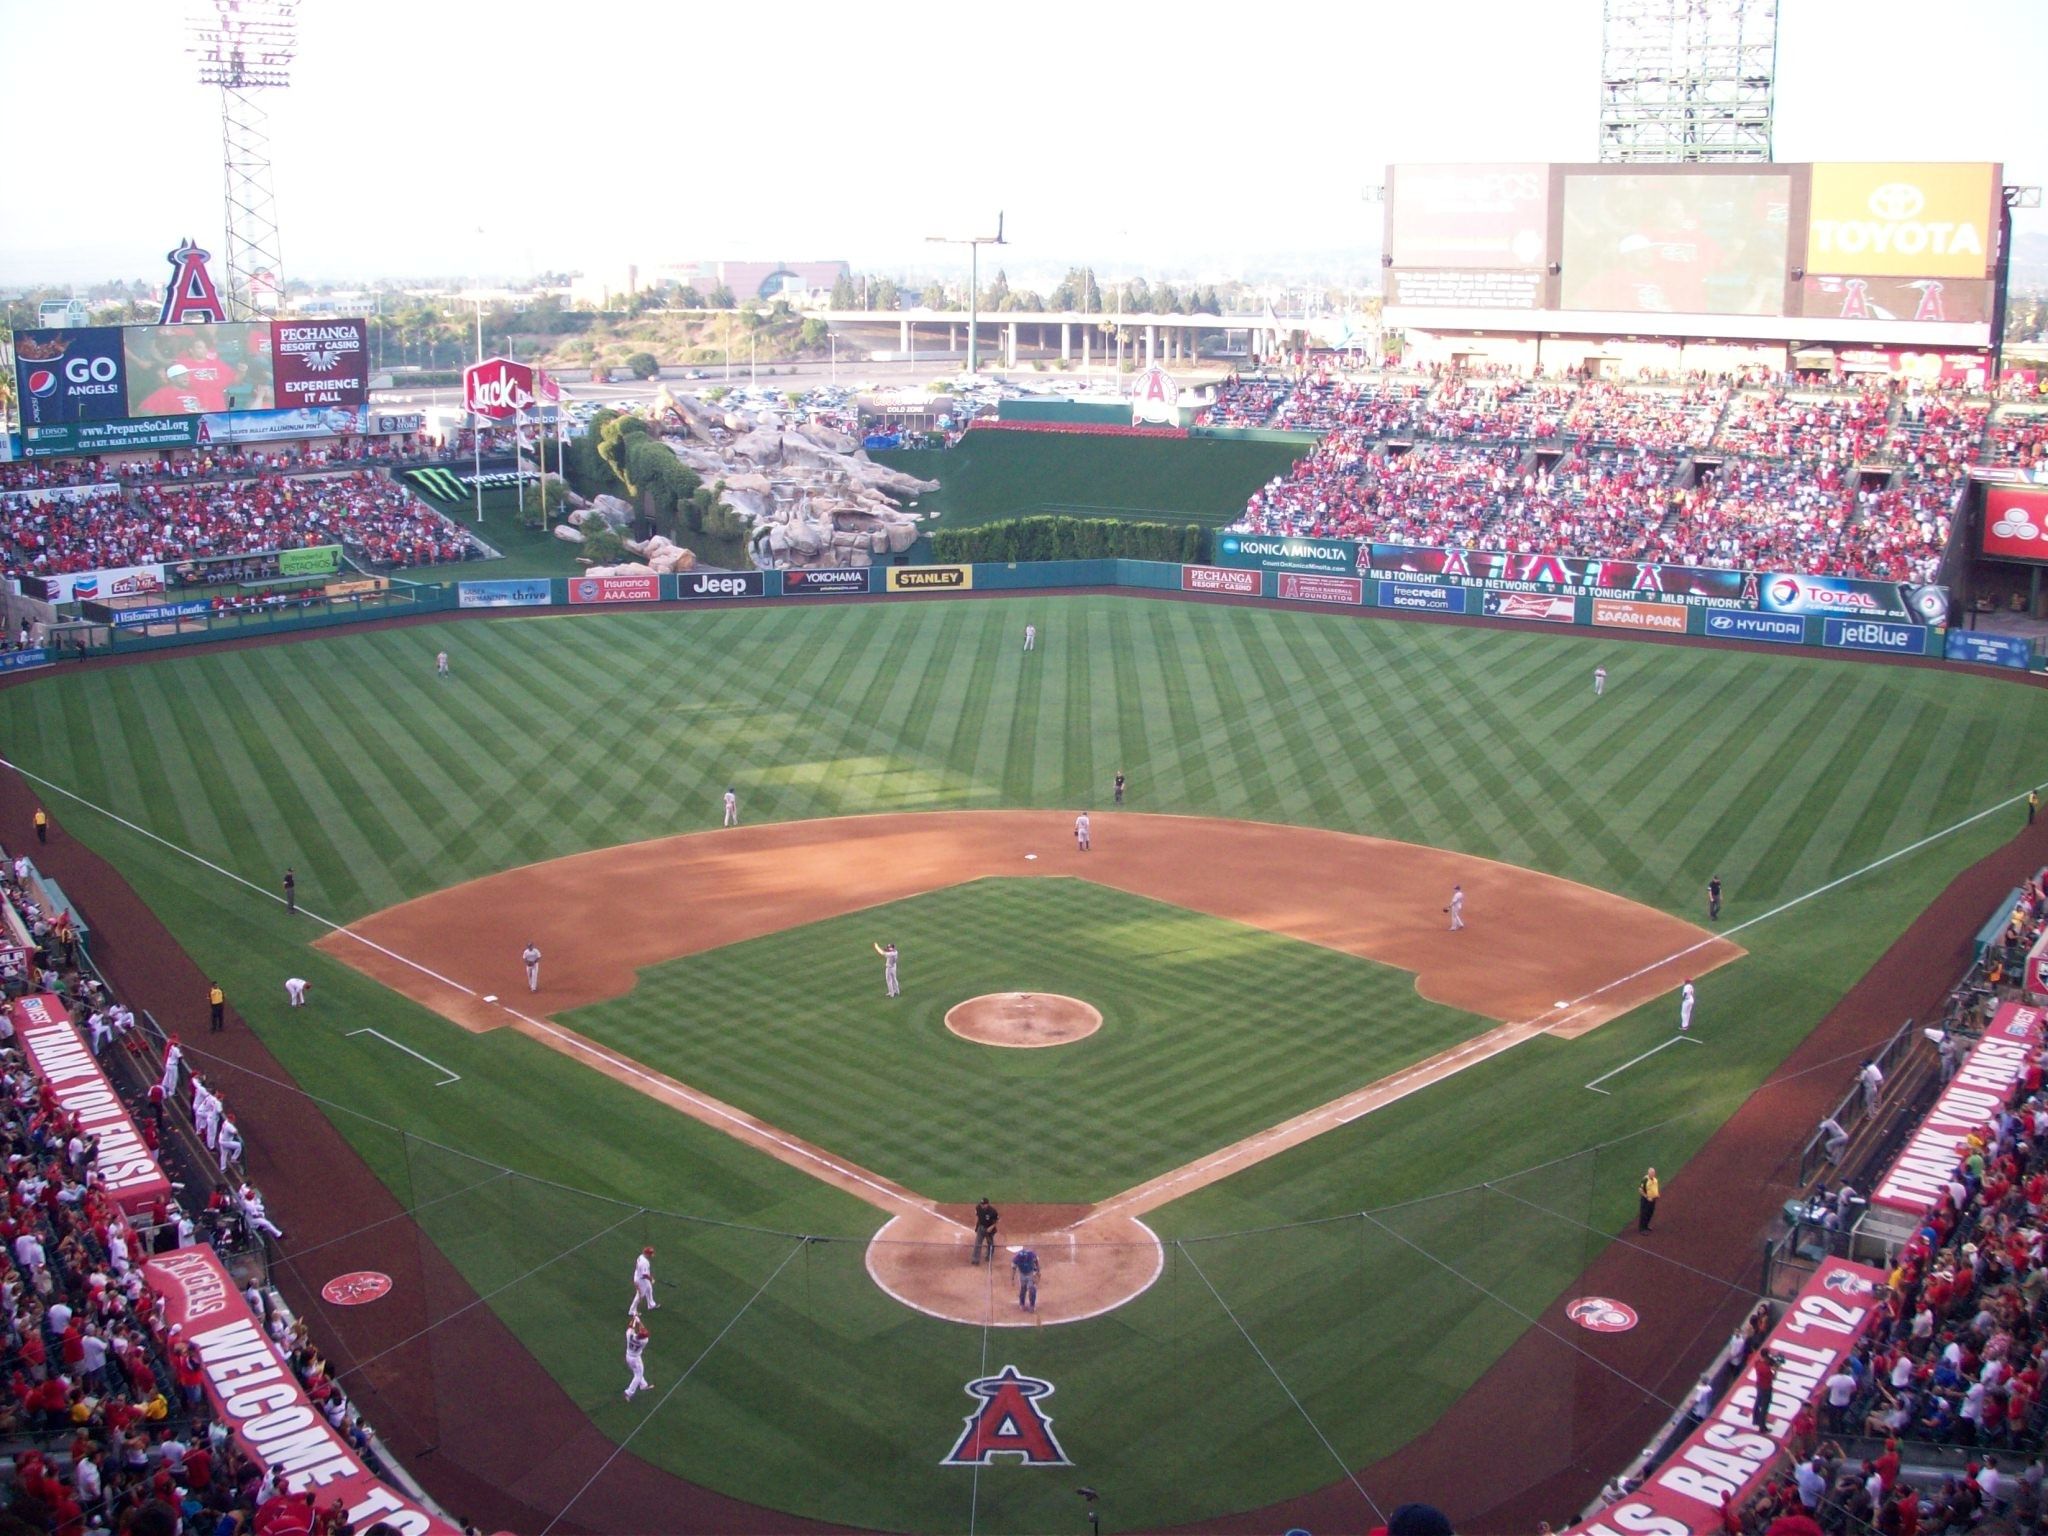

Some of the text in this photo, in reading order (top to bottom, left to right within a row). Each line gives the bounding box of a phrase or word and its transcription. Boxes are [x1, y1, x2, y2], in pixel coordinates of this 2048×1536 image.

[1812, 220, 1983, 255] TOYOTA
[280, 327, 359, 340] PECHANGA
[280, 341, 359, 351] RESORT CASINO
[65, 357, 117, 383] GO
[67, 384, 118, 396] ANGELS!
[285, 379, 359, 392] EXPERIENCE
[470, 366, 524, 412] Jack
[304, 392, 341, 402] IT ALL
[80, 420, 189, 437] www.PrepareSoCal.org
[1240, 541, 1347, 561] KONICA MINOLTA
[604, 579, 651, 588] Insurance
[806, 572, 863, 582] YOKOHAMA
[900, 572, 959, 585] STANLEY
[1191, 569, 1252, 584] PECHANGA
[1370, 569, 1439, 584] MLB TONIGHT
[693, 575, 747, 596] Jeep
[1192, 580, 1252, 592] RESORT CASINO
[1461, 577, 1538, 592] MLB NETWORK
[512, 589, 546, 600] thrive
[604, 590, 651, 600] AAA.com
[1300, 592, 1353, 601] FOUNDATION
[1394, 586, 1447, 599] freecredit
[1563, 585, 1636, 600] MLB TONIGHT
[1394, 597, 1448, 608] score.com
[1661, 593, 1742, 609] MLB NETWORK
[1597, 610, 1682, 628] SAFARI PARK
[1737, 619, 1799, 634] HYUNDAI
[1840, 623, 1908, 646] jetBlue
[24, 1021, 161, 1190] THANK YOU FANS!
[1877, 1036, 2032, 1205] THANK YOU FANS!
[148, 1253, 226, 1321] ANGELS
[190, 1318, 359, 1493] WELCOME
